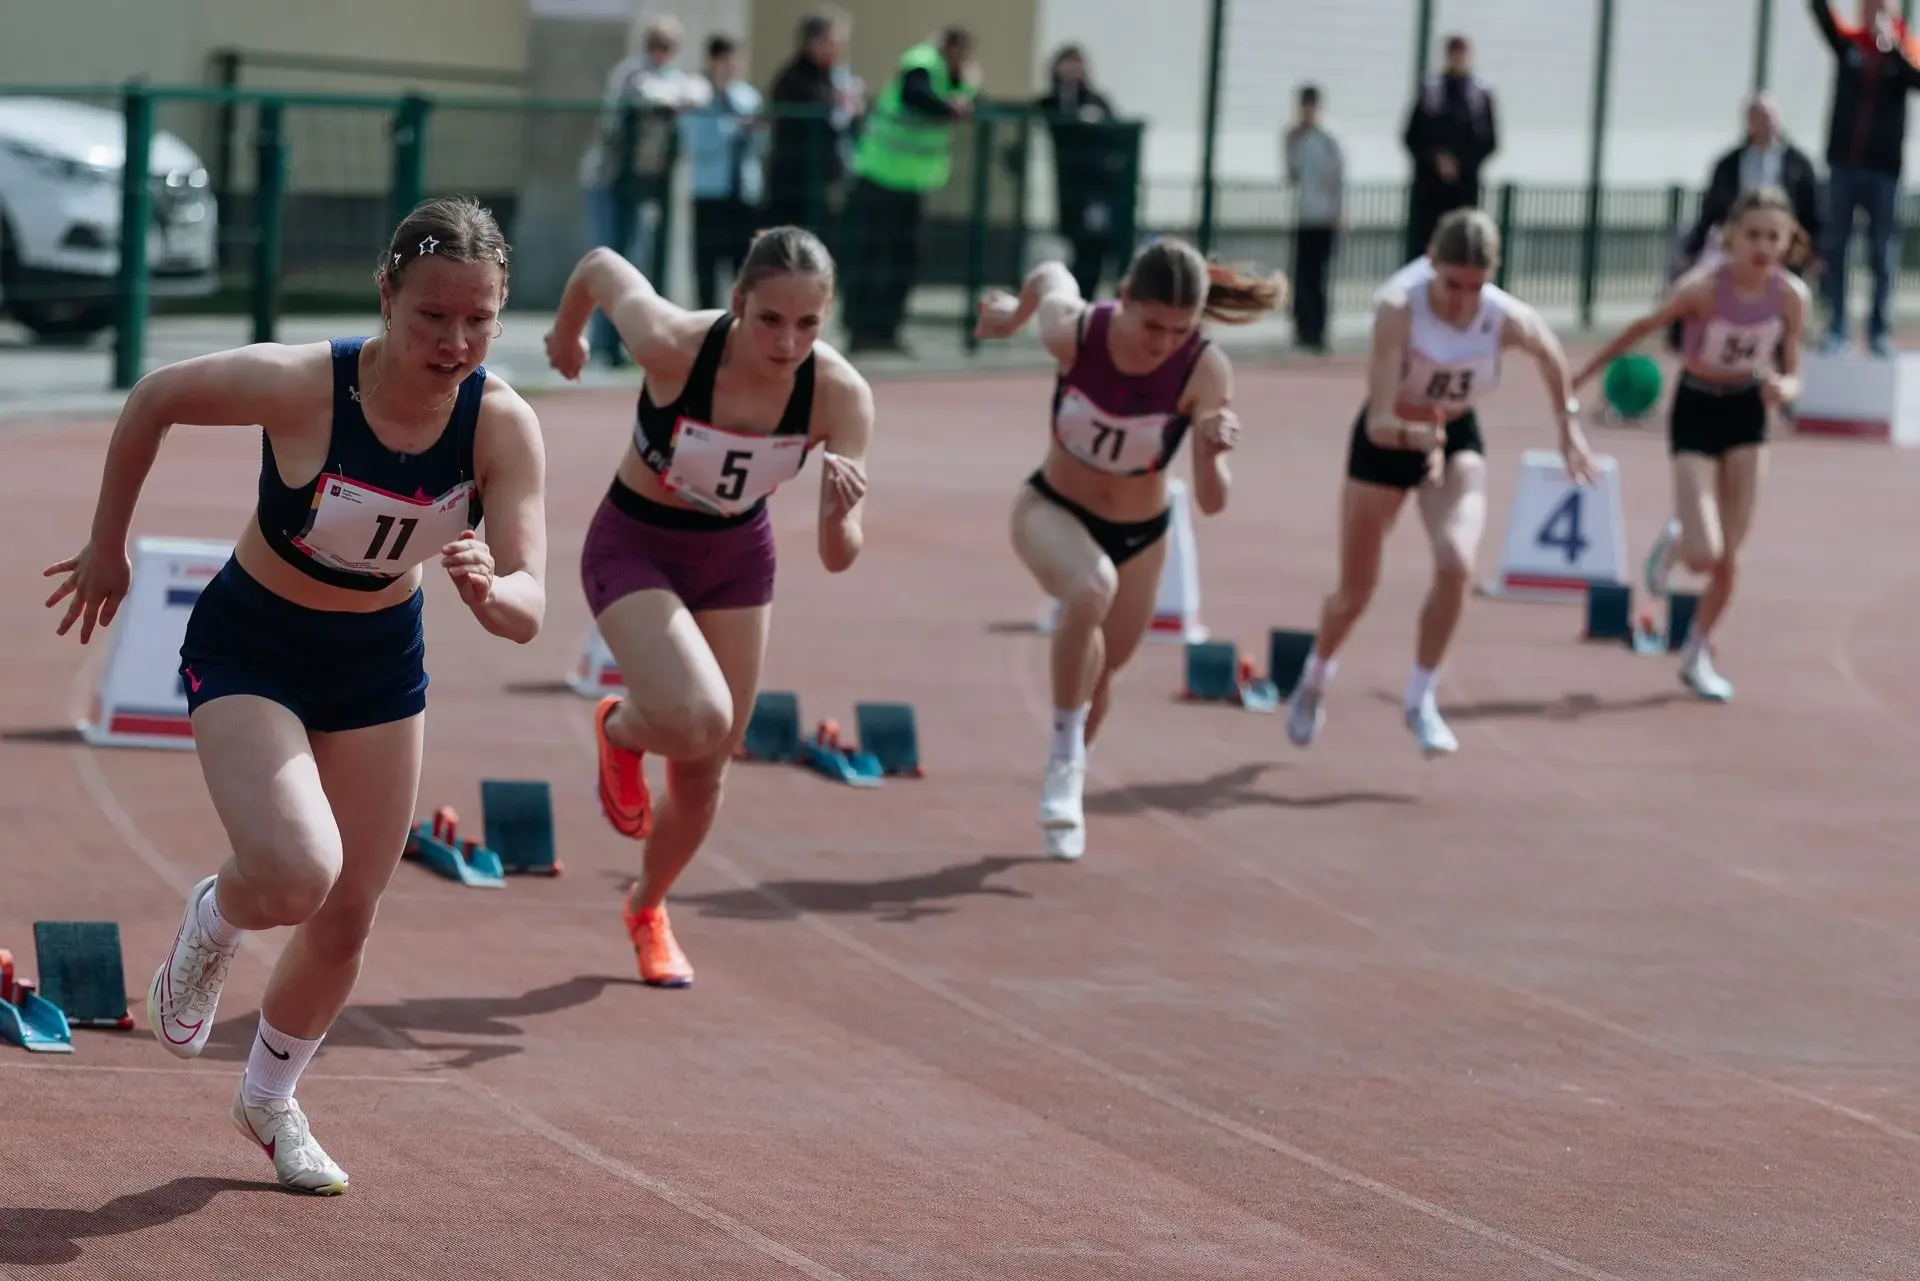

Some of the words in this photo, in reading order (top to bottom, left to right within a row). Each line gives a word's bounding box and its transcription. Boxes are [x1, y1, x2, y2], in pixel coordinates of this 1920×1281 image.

[1091, 418, 1126, 462] 71
[715, 449, 753, 501] 5
[363, 514, 419, 560] 11
[1536, 489, 1591, 564] 4
